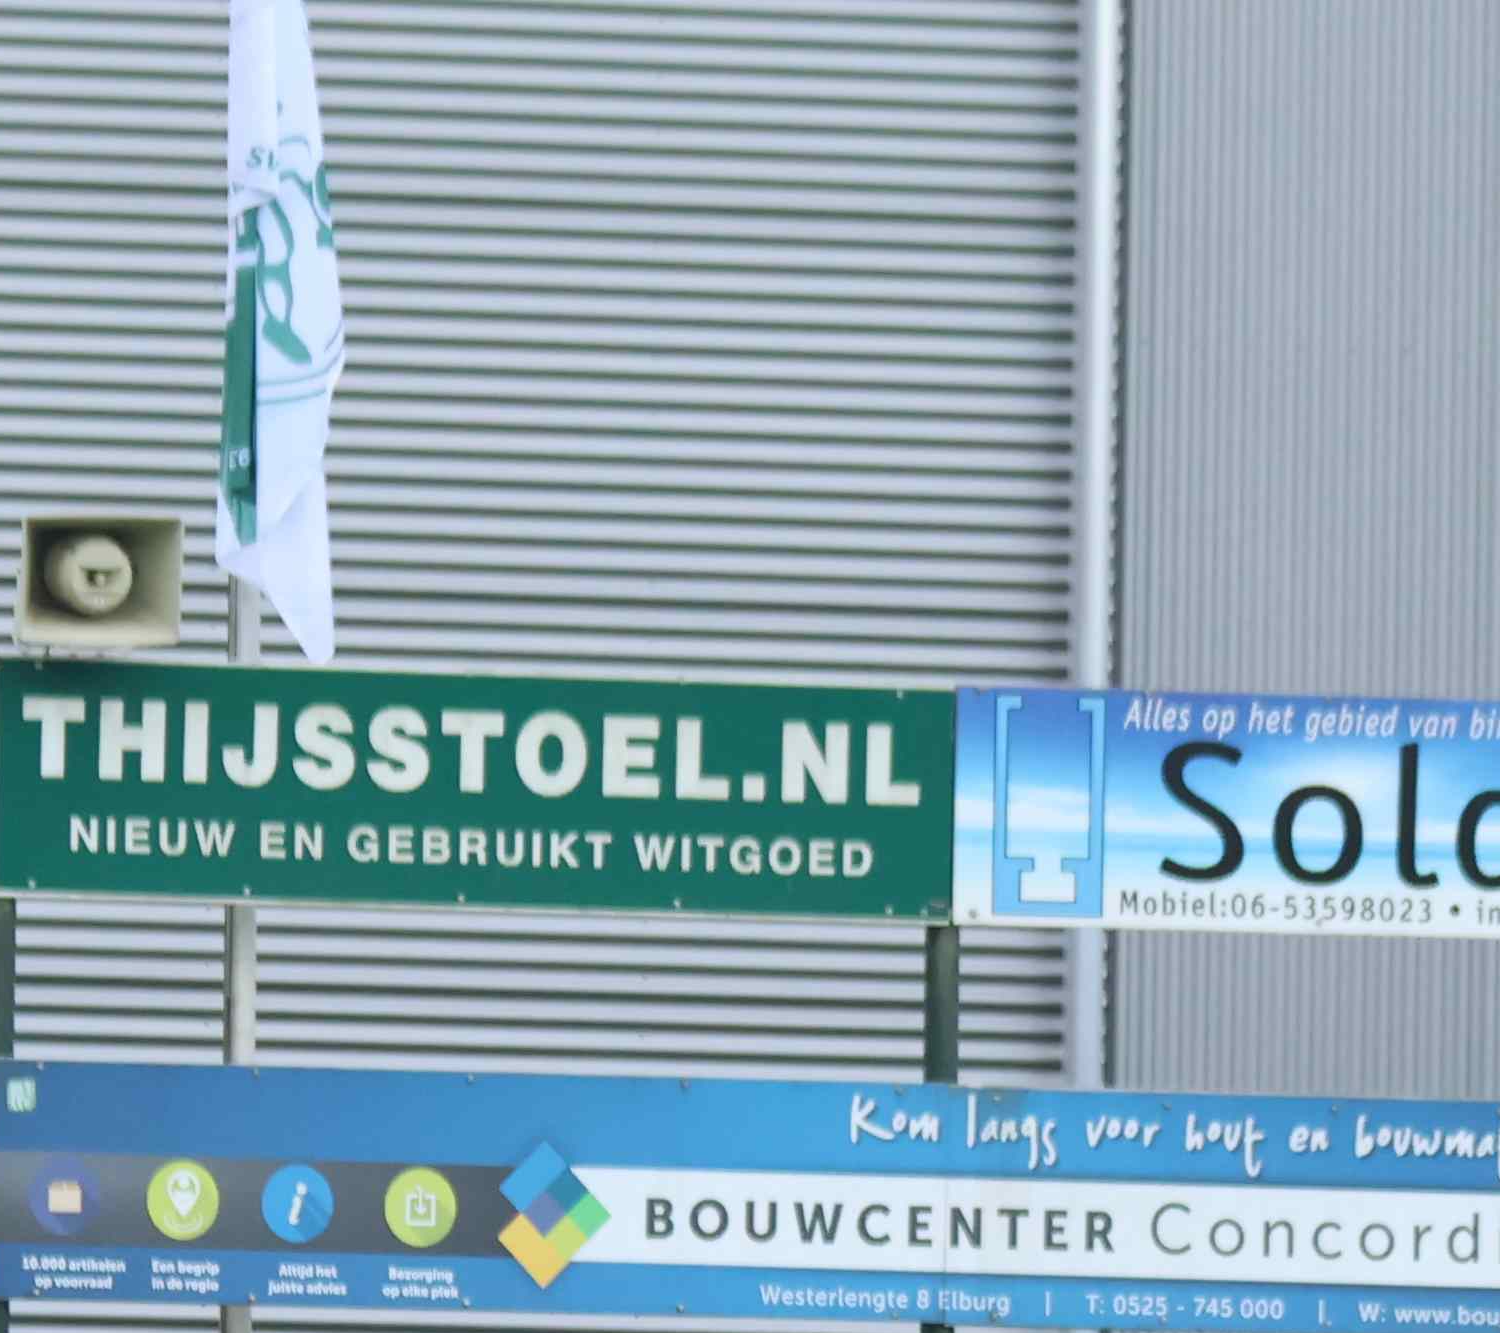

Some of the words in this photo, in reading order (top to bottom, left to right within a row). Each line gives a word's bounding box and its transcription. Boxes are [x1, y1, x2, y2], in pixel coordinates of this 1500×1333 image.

[1124, 699, 1190, 733] Alles
[1202, 709, 1236, 739] op
[1248, 702, 1293, 735] het
[1305, 704, 1398, 742] gebied
[1409, 715, 1457, 739] van
[23, 696, 920, 806] THIJSSTOEL.NL
[69, 815, 236, 856] NIEUW
[261, 821, 324, 861] EN
[348, 827, 612, 870] GEBRUIKT
[634, 835, 873, 877] WITGOED
[850, 1092, 940, 1144] Kom
[966, 1093, 1057, 1170] langs
[1086, 1115, 1161, 1148] voor
[1185, 1111, 1263, 1178] hout
[1289, 1126, 1330, 1156] en
[644, 1196, 1115, 1253] BOUWCENTER
[55, 1275, 113, 1290] voorraad
[759, 1283, 909, 1312] Westerlengte
[916, 1289, 932, 1310] 8
[938, 1291, 1011, 1316] Elburg
[1086, 1294, 1105, 1315] T:
[1112, 1295, 1168, 1317] 0525
[1193, 1297, 1234, 1319] 745
[1240, 1299, 1285, 1320] 000
[1357, 1302, 1386, 1323] W:
